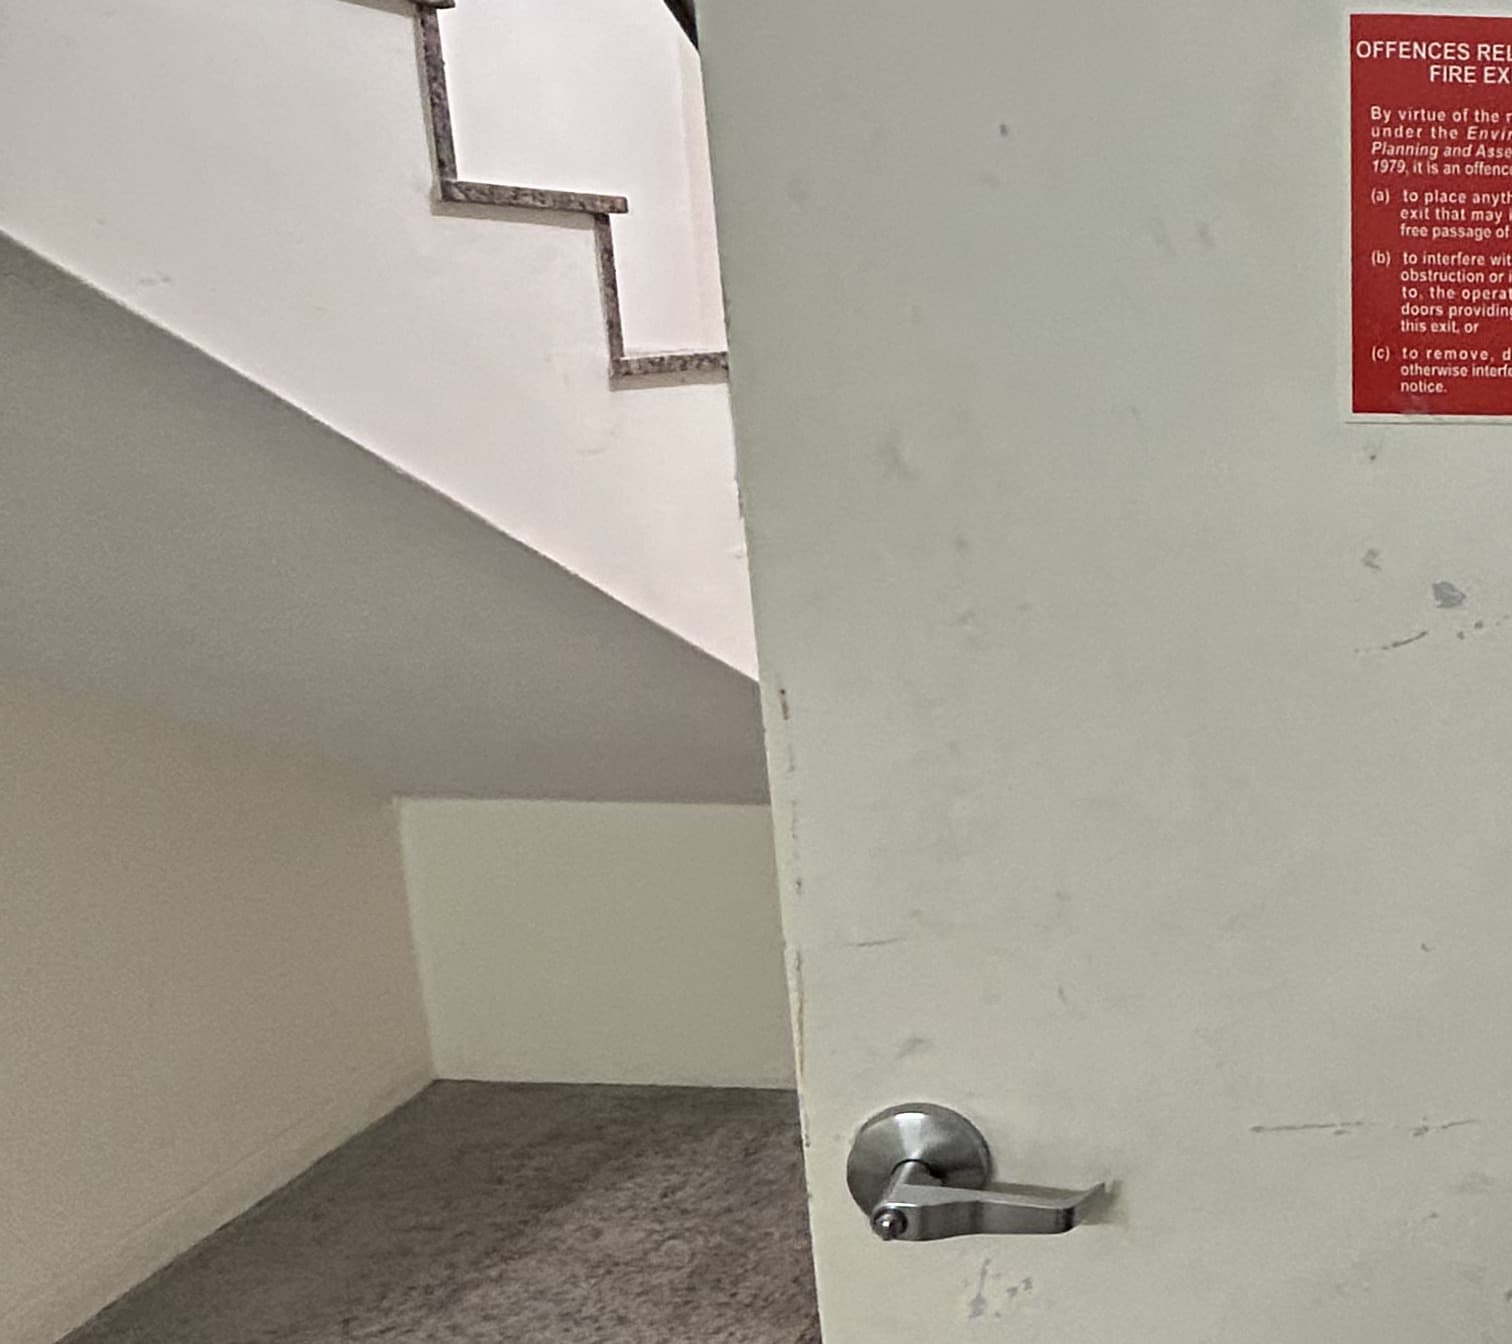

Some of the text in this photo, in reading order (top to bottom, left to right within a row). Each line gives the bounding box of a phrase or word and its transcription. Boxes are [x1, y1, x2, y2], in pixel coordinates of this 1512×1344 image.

[1355, 40, 1470, 61] OFFENCES
[1429, 64, 1477, 83] FIRE
[1370, 105, 1392, 124] By
[1398, 107, 1446, 122] virtue
[1452, 108, 1469, 122] of
[1474, 108, 1500, 123] the
[1371, 124, 1423, 138] under
[1431, 125, 1458, 140] the
[1371, 141, 1439, 161] Planning
[1443, 144, 1473, 157] and
[1372, 159, 1409, 176] 1979,
[1413, 160, 1423, 174] it
[1426, 160, 1439, 175] is
[1443, 164, 1461, 175] an
[1371, 188, 1390, 205] (a)
[1403, 189, 1419, 203] to
[1424, 189, 1467, 206] place
[1400, 207, 1430, 220] exit
[1435, 206, 1466, 221] that
[1471, 210, 1503, 225] may
[1400, 223, 1428, 237] free
[1432, 226, 1492, 241] passage
[1495, 225, 1510, 238] of
[1371, 250, 1391, 268] (b)
[1403, 252, 1418, 265] to
[1422, 251, 1485, 266] interfere
[1400, 268, 1484, 283] obstruction
[1488, 272, 1505, 283] or
[1429, 286, 1456, 299] the
[1401, 302, 1444, 316] doors
[1400, 319, 1479, 334] this exit, or
[1372, 346, 1390, 362] (c)
[1402, 347, 1418, 360] to
[1426, 349, 1494, 362] remove,
[1400, 363, 1468, 377] otherwise
[1401, 380, 1447, 393] notice.
